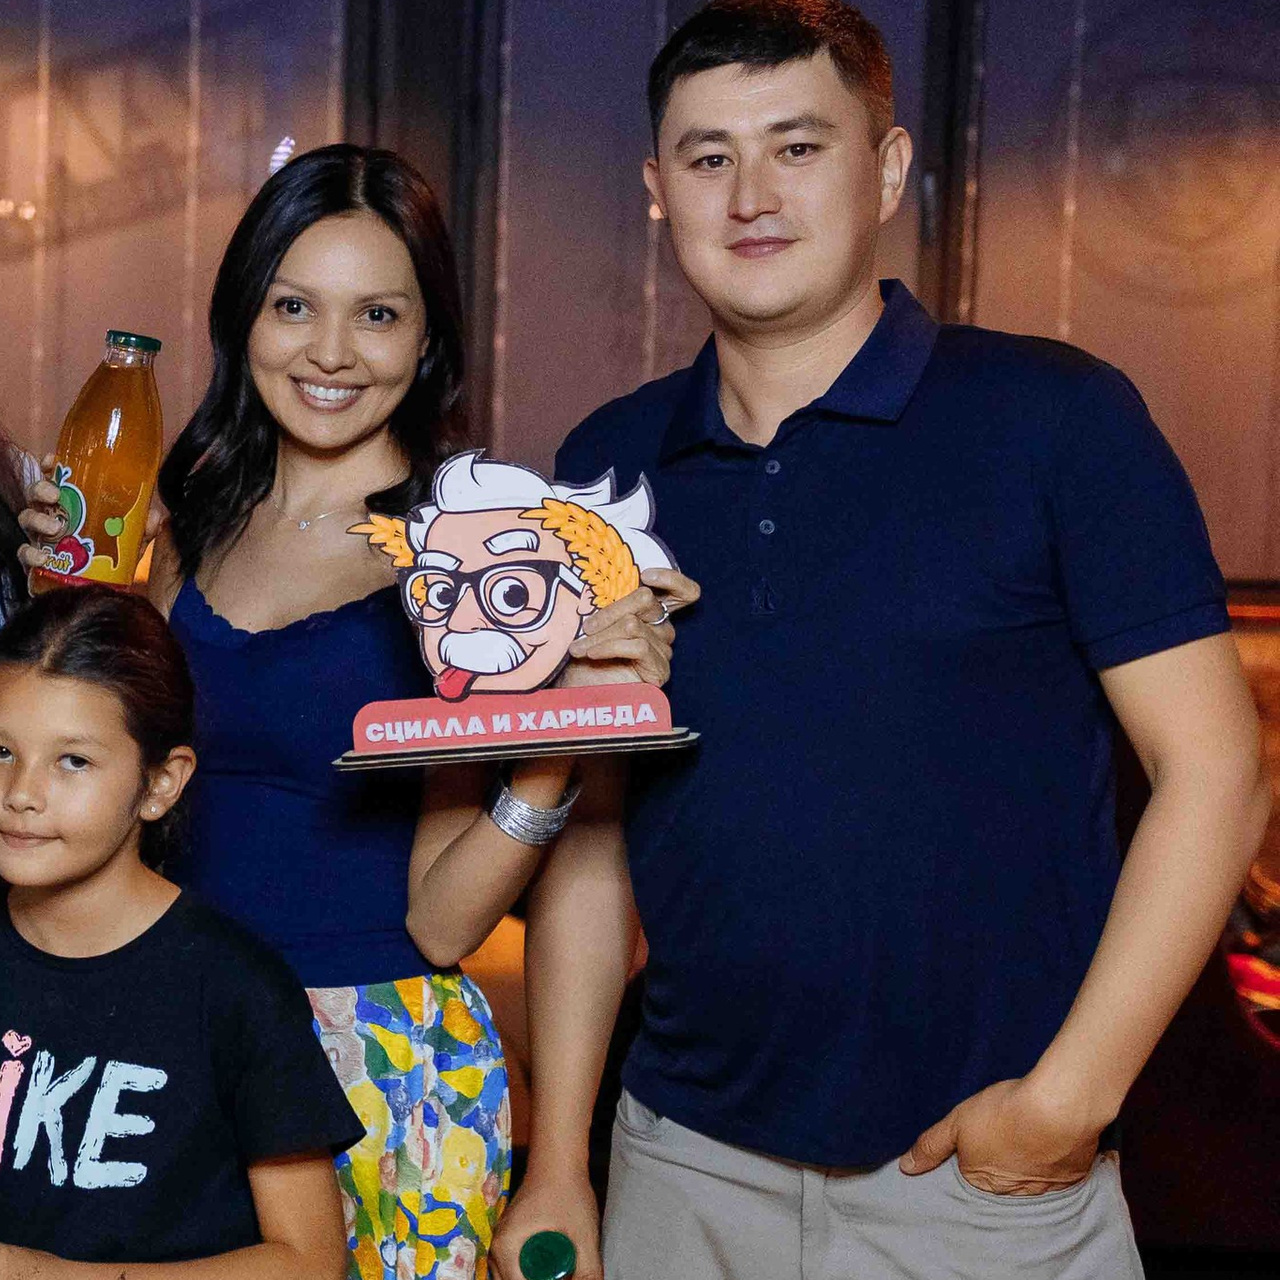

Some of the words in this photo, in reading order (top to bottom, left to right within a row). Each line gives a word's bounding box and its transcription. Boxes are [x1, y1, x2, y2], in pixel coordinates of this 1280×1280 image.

[364, 713, 486, 744] СЦИЛЛА
[491, 712, 512, 733] И
[517, 703, 658, 732] ХАРИБДА
